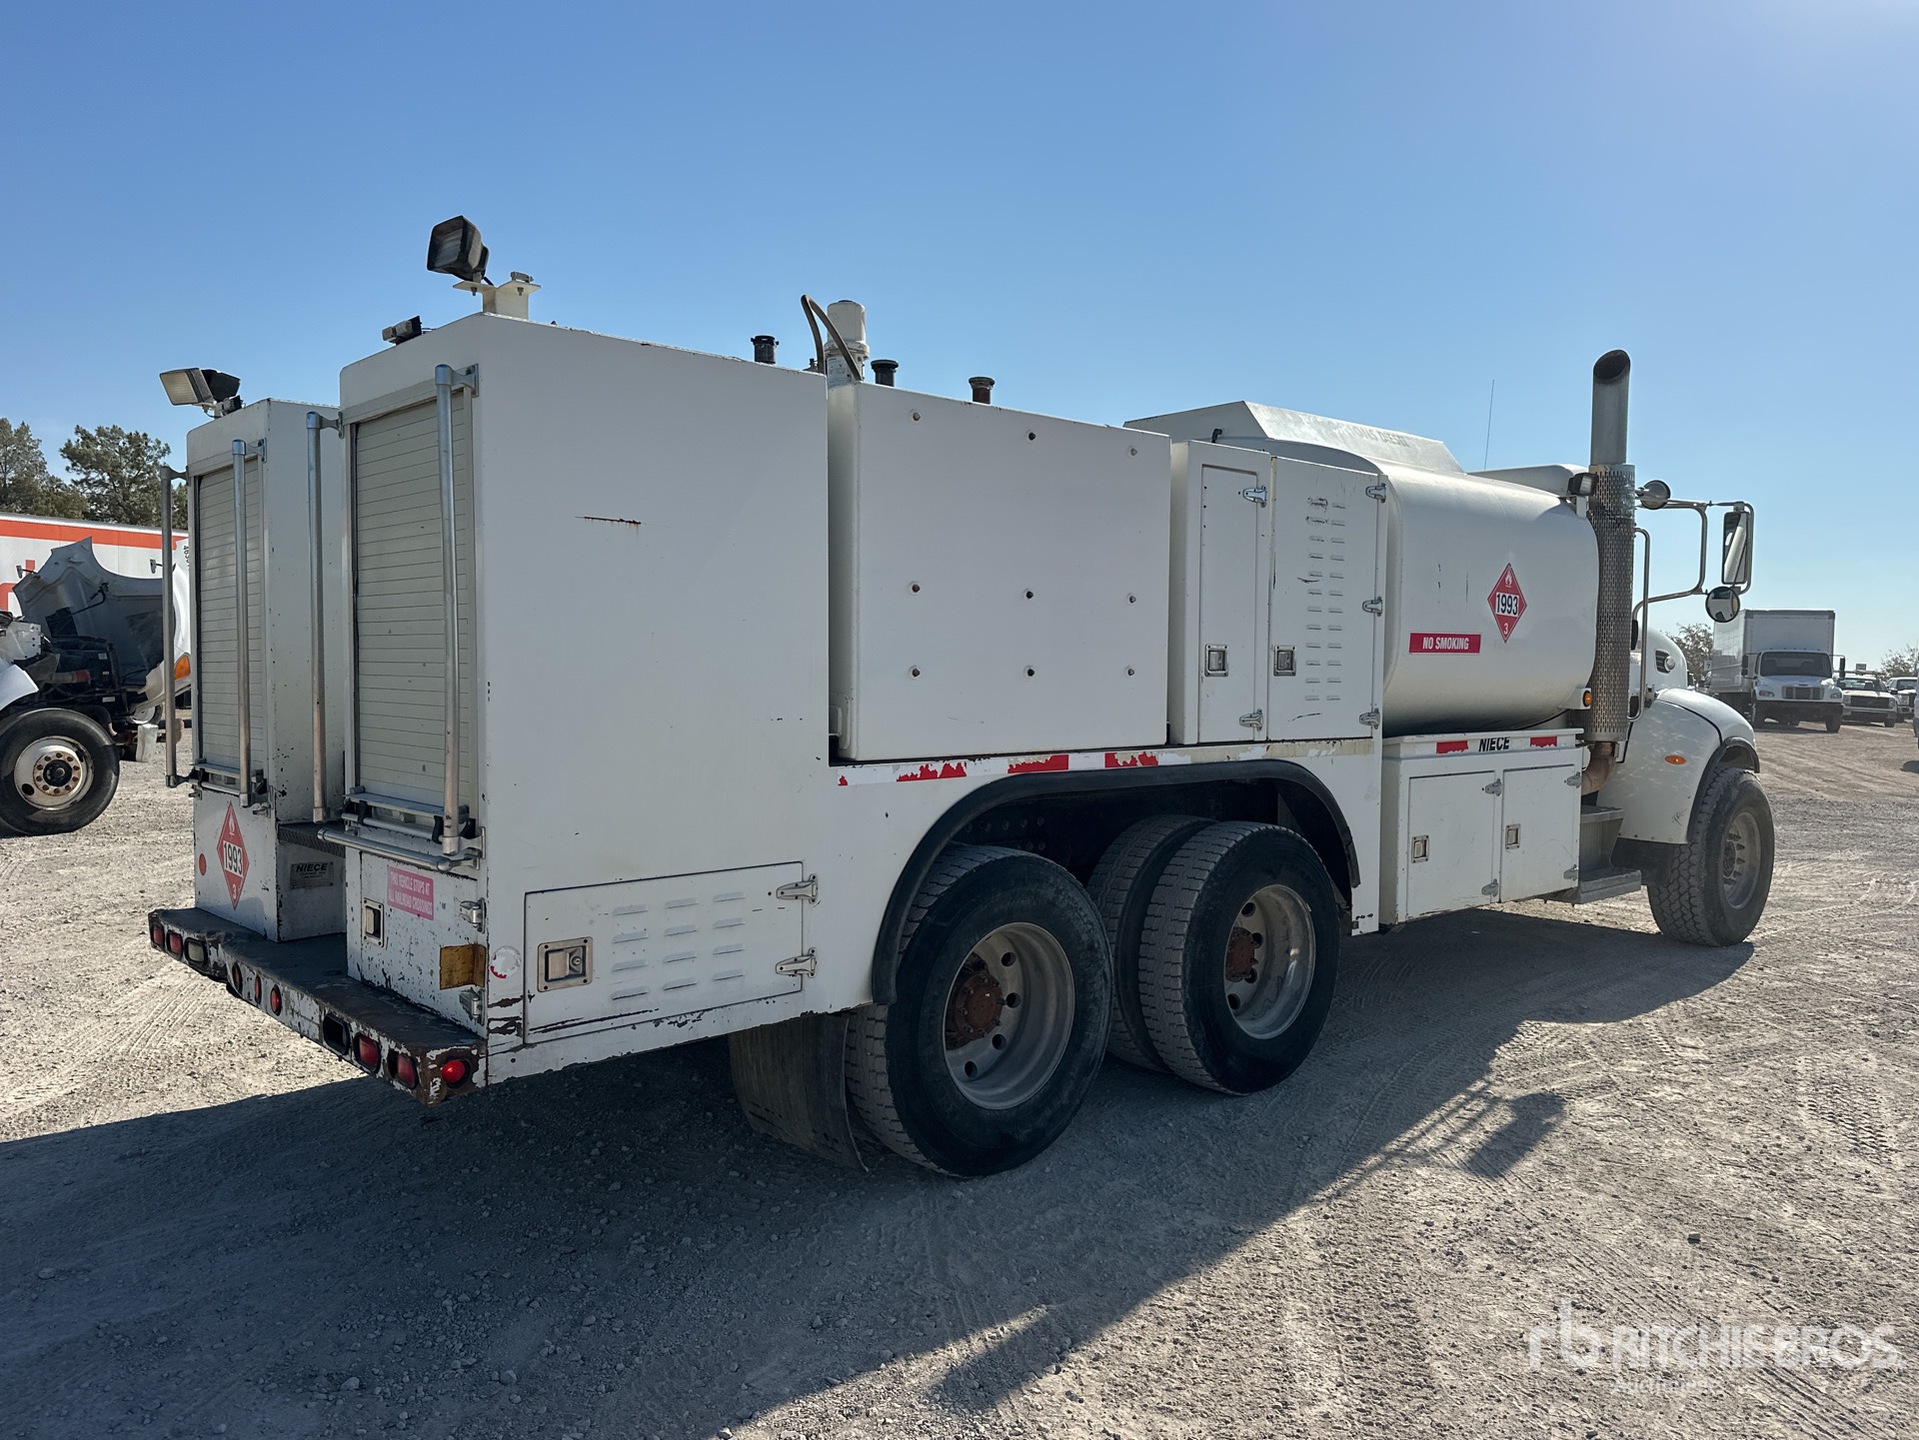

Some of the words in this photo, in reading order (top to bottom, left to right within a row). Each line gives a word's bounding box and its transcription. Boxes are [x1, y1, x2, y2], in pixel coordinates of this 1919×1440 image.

[1496, 593, 1519, 616] 1993
[1503, 622, 1509, 635] 3
[1422, 637, 1434, 650] NO
[1435, 637, 1470, 650] SMOKING
[1478, 737, 1510, 752] NIECE
[223, 842, 243, 875] 1993
[296, 862, 329, 873] NIECE
[232, 883, 237, 900] 3
[425, 882, 431, 897] AT
